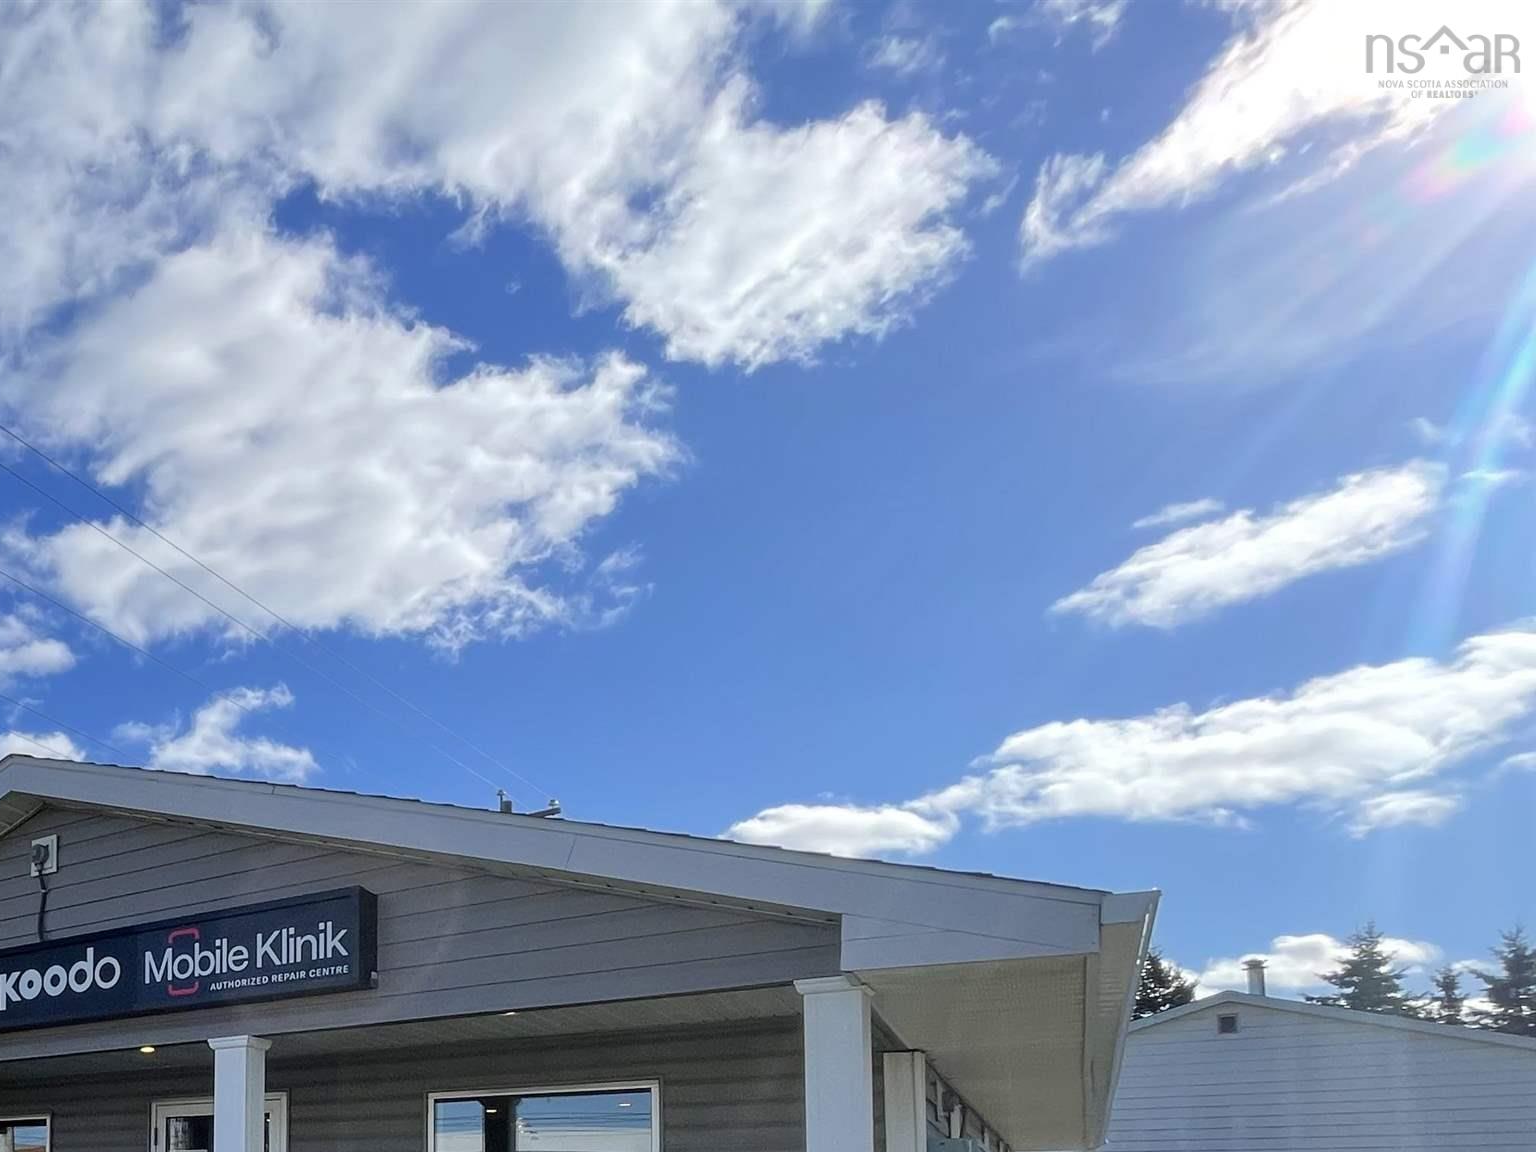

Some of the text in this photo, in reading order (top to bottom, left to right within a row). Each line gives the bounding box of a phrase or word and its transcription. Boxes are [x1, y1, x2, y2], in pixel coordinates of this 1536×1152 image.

[144, 920, 349, 985] Mobile Klinik
[209, 964, 349, 991] AUTHORIZED REPAIR CENTRE
